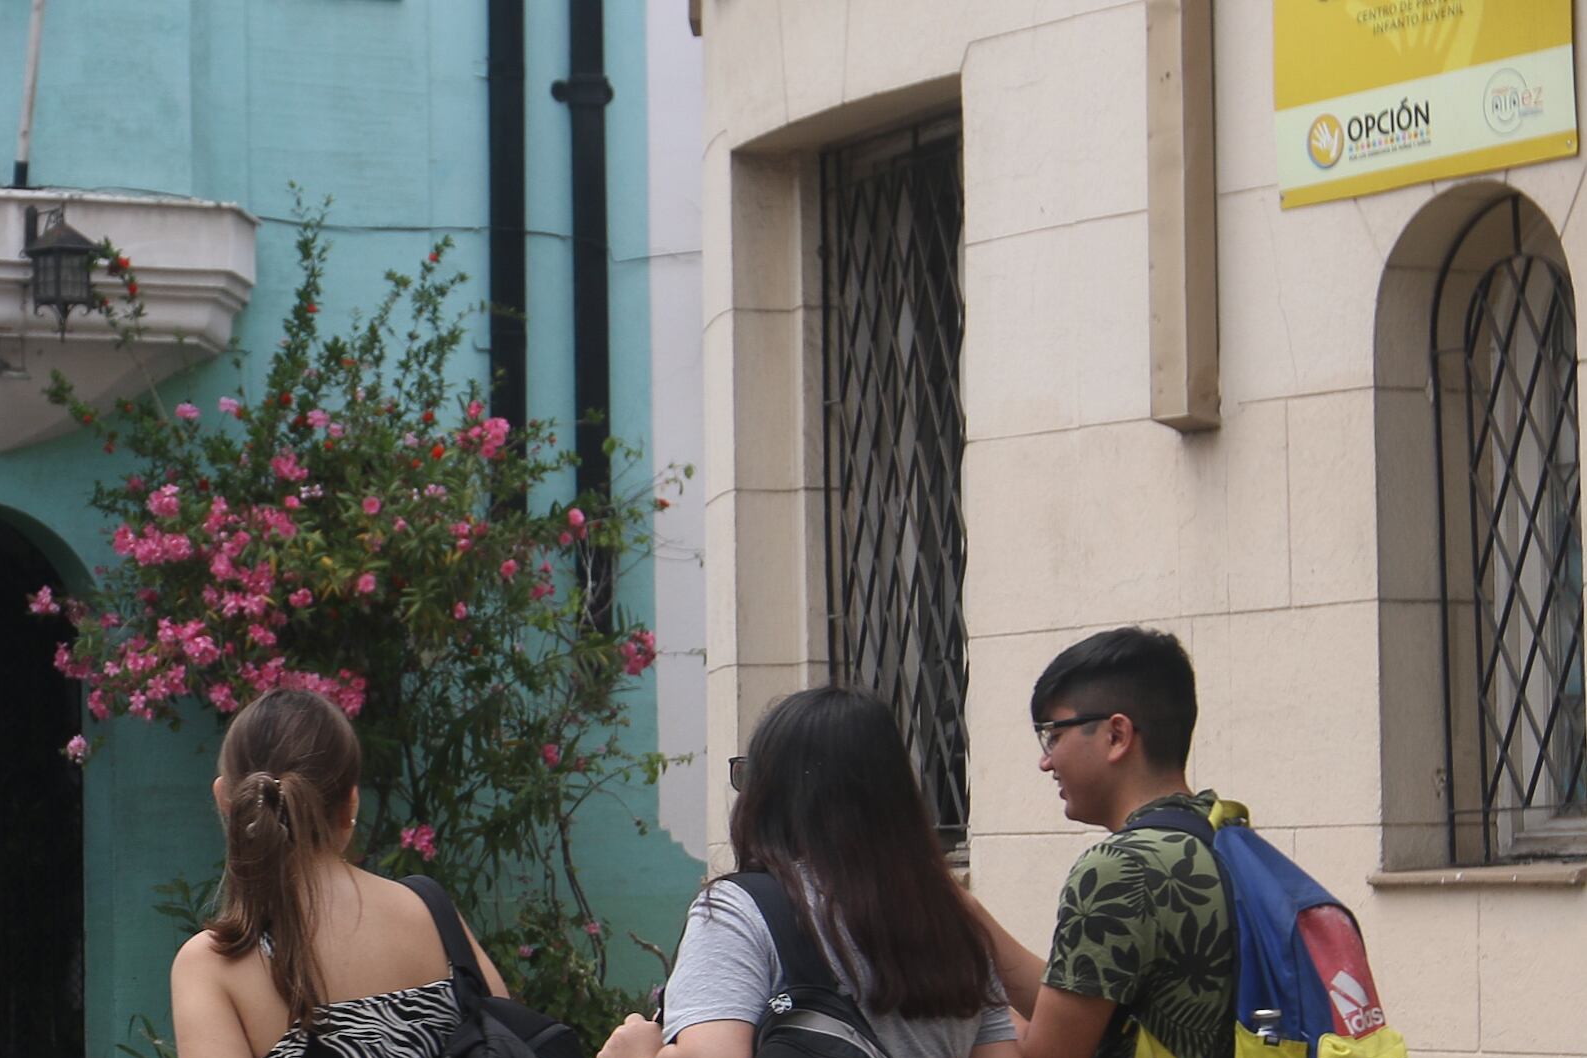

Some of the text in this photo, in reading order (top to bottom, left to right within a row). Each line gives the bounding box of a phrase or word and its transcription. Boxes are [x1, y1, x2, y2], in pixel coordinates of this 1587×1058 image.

[1356, 4, 1398, 24] CENTRO
[1373, 13, 1419, 34] INFANTO
[1422, 1, 1464, 22] JUVENIL
[1347, 96, 1431, 142] OPCIÓN
[1344, 1007, 1384, 1036] idas
